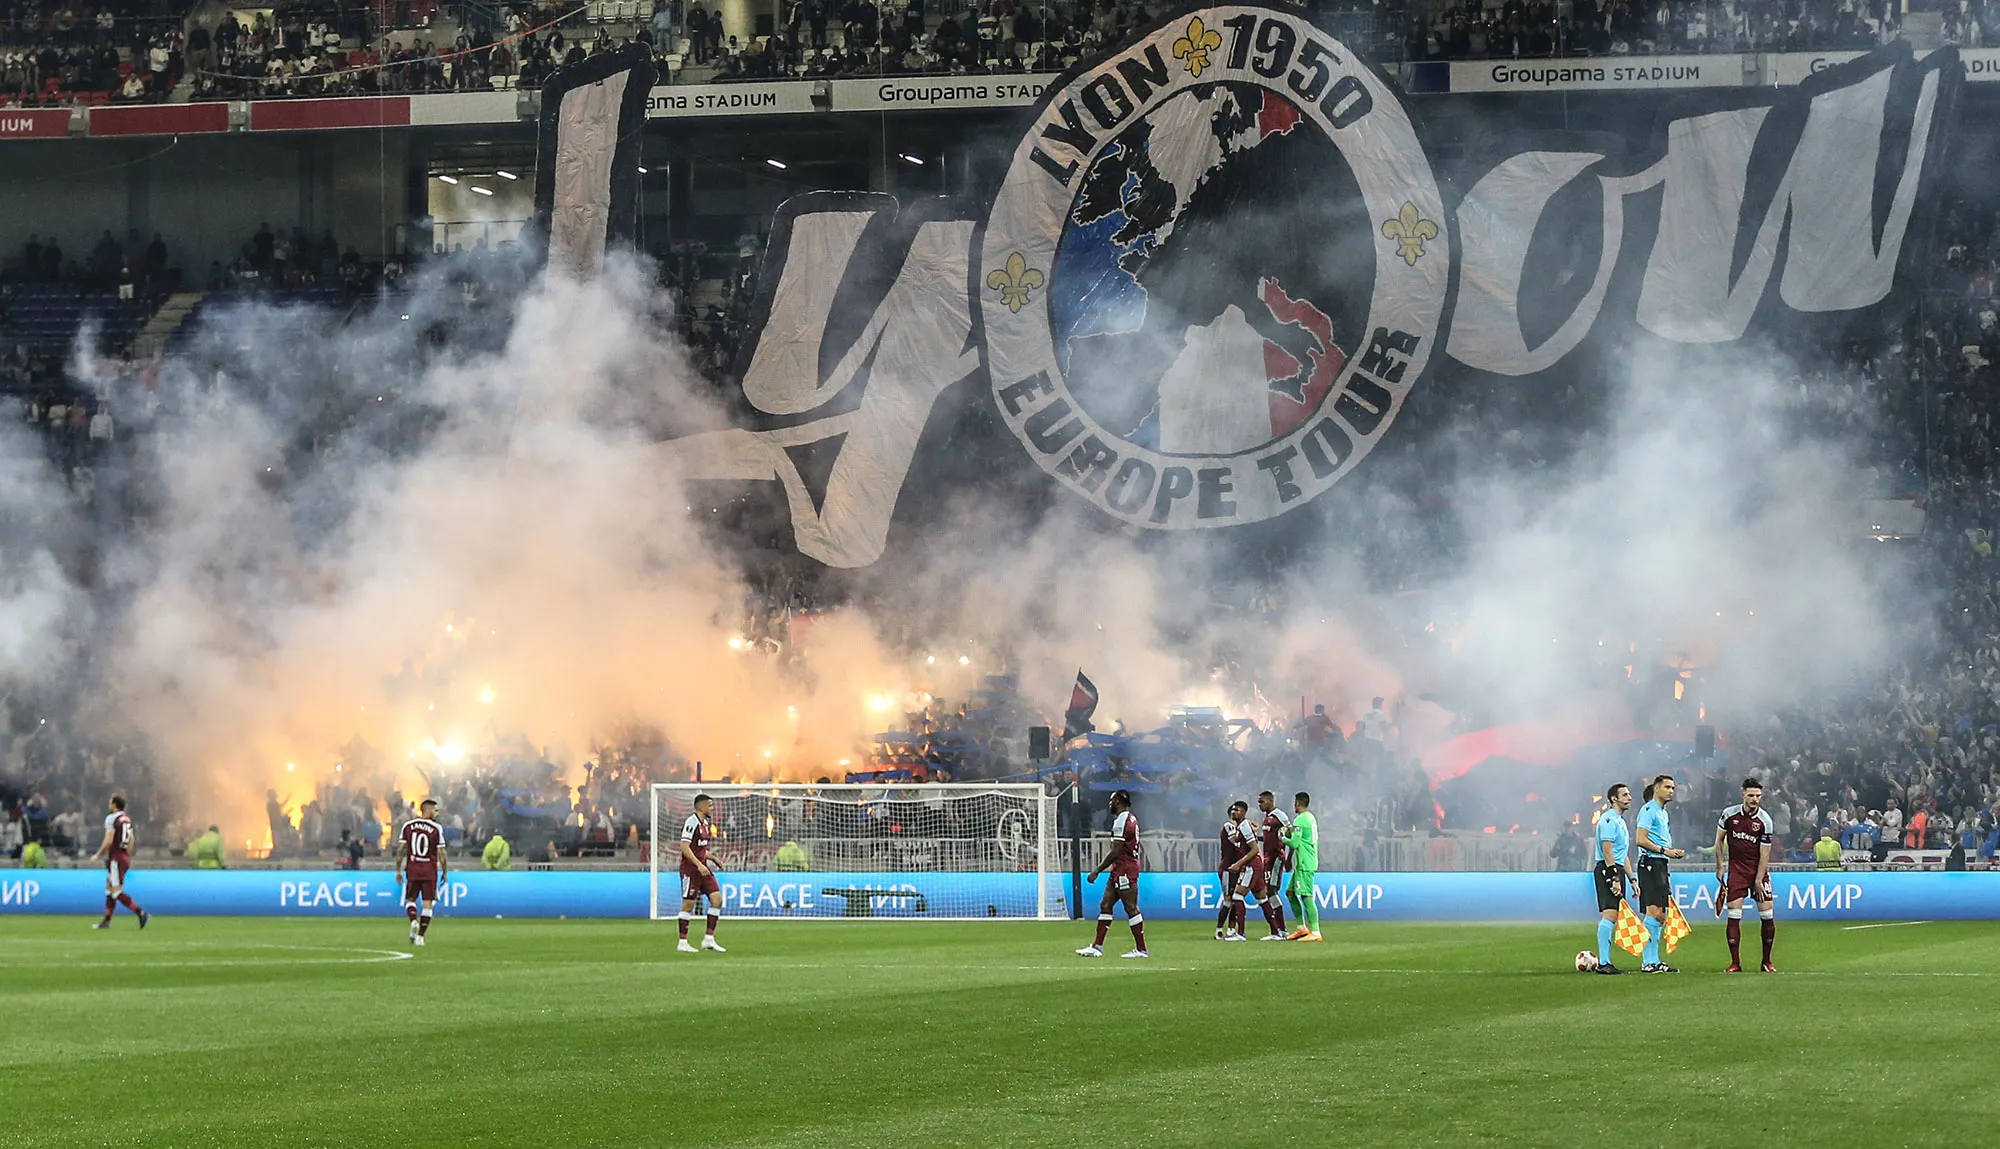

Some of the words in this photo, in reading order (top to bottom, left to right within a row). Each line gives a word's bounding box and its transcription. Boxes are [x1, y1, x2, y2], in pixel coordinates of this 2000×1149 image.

[1224, 13, 1374, 130] 1950
[1491, 65, 1605, 86] Groupama
[1613, 66, 1700, 81] STADIUM
[695, 93, 776, 108] STADIUM
[878, 84, 988, 104] Groupama
[996, 84, 1049, 98] STAD
[1030, 43, 1170, 188] LYON
[999, 370, 1237, 524] EUROPE
[1258, 326, 1422, 504] TOUR
[411, 832, 429, 857] 10
[1732, 830, 1758, 844] betway
[281, 882, 369, 906] PEACE
[722, 884, 814, 908] PEACE
[1788, 884, 1863, 909] МИР
